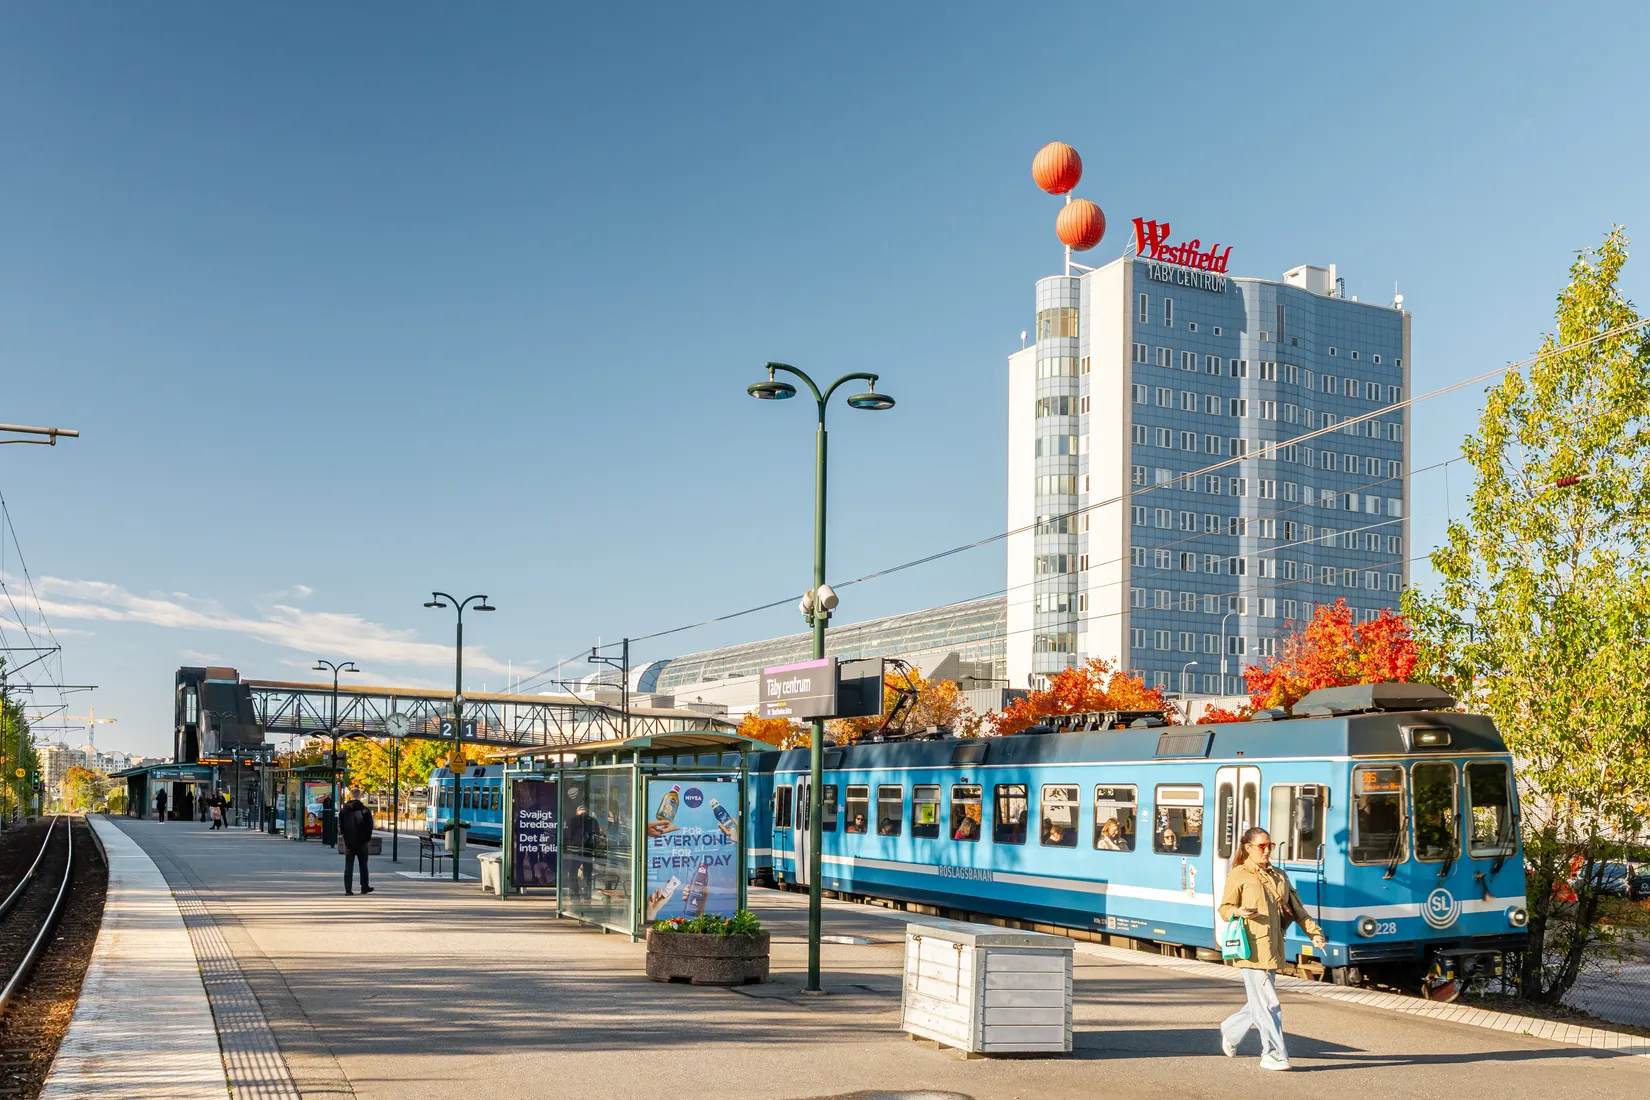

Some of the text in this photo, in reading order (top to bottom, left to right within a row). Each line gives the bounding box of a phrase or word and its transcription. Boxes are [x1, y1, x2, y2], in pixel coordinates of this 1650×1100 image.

[1130, 217, 1234, 274] Westfield
[1176, 269, 1227, 294] CENTRUM
[766, 676, 811, 699] Täby centrum
[442, 723, 452, 736] 2
[465, 724, 473, 737] 1
[519, 810, 552, 821] Svajigt
[682, 827, 702, 835] FOR
[519, 834, 550, 842] Det är
[653, 834, 732, 847] EVERYONE
[519, 844, 538, 852] inte
[672, 848, 692, 857] FOR
[652, 854, 732, 869] EVERY DAY
[939, 865, 993, 883] ROSLAGSBANAN
[1431, 896, 1450, 912] SL
[1376, 922, 1397, 935] 228
